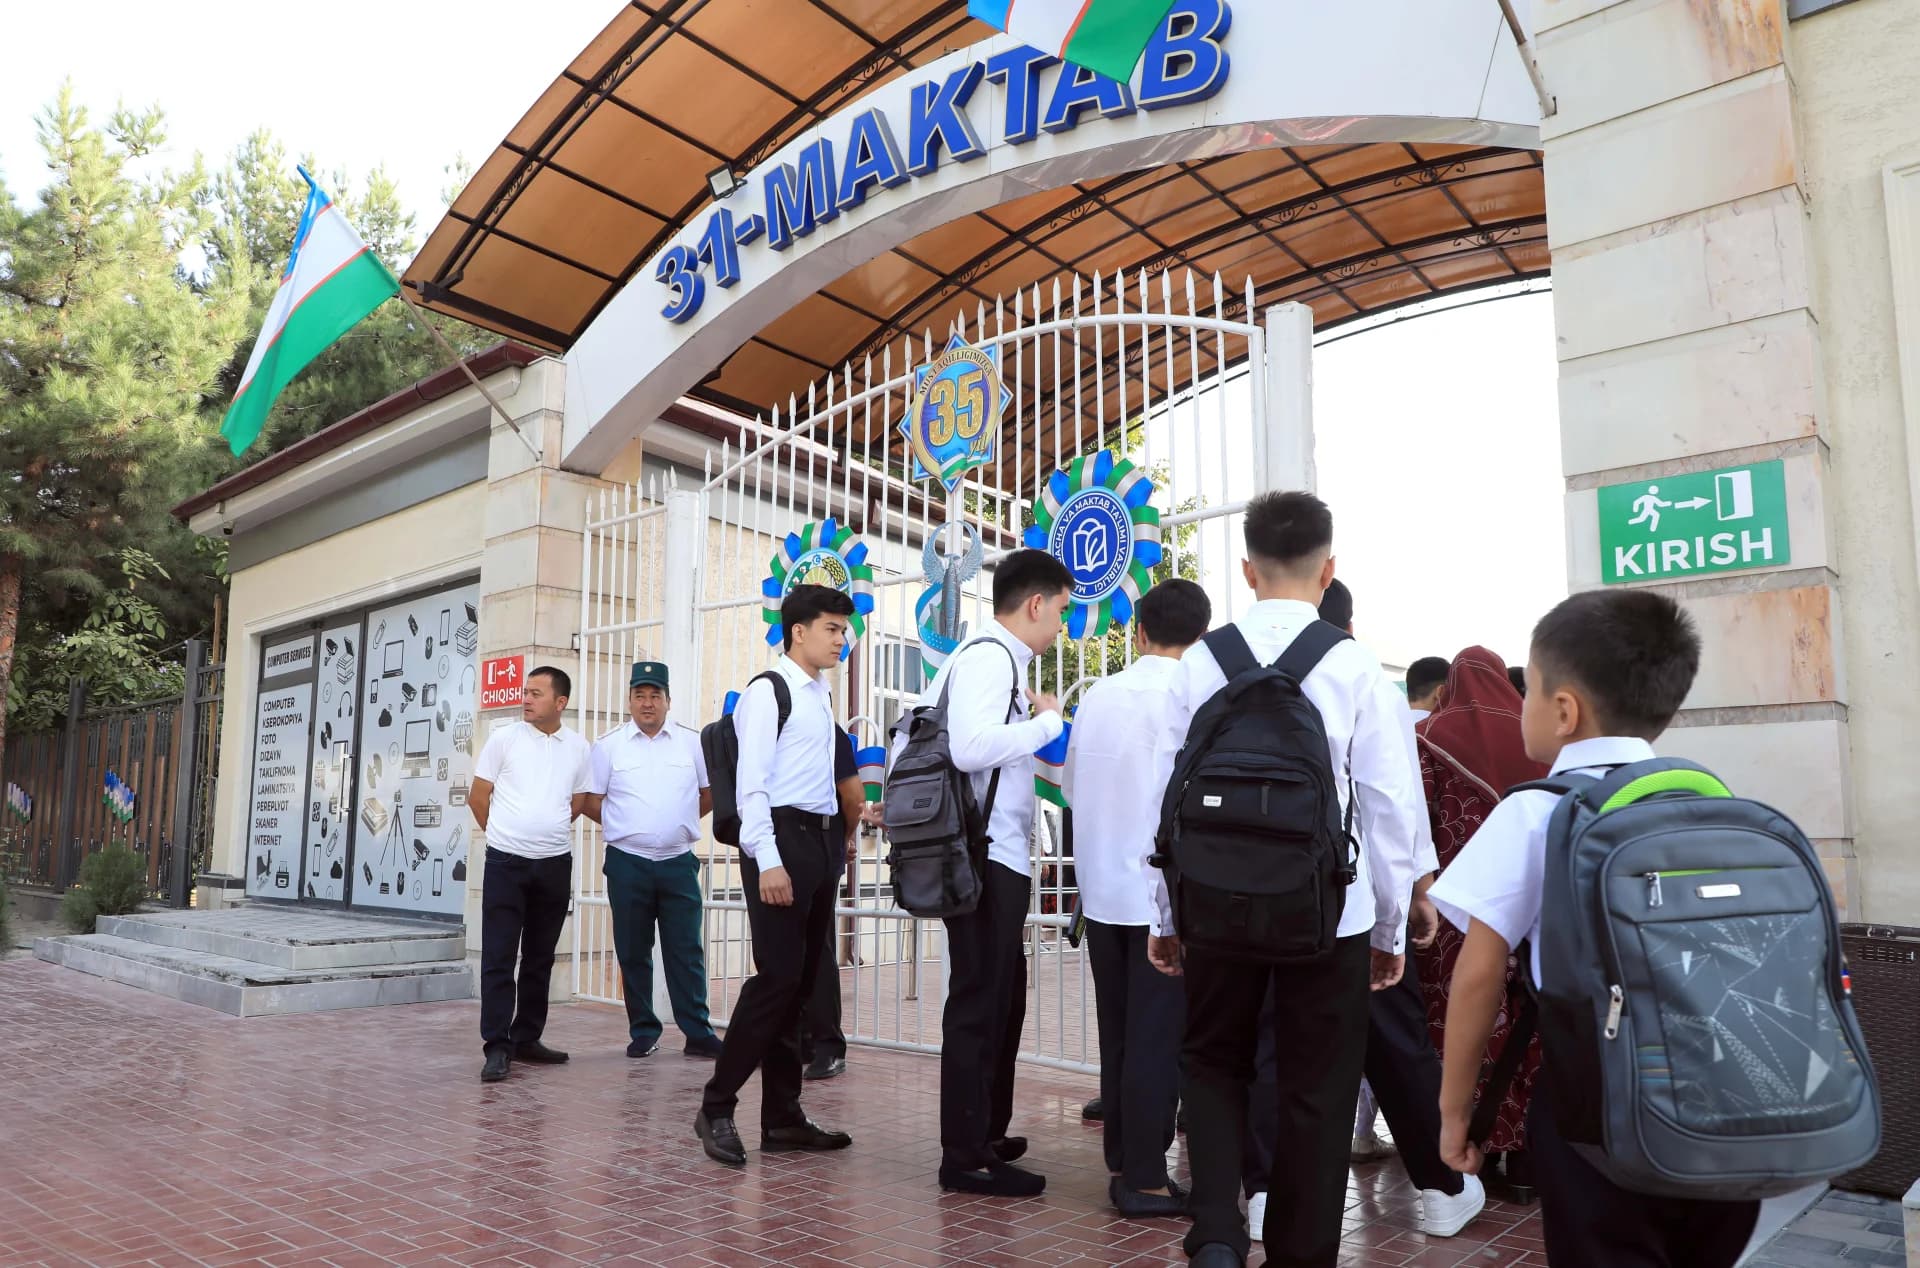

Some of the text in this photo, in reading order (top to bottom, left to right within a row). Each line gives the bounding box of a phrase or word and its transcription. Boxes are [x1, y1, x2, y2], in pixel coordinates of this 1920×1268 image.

[655, 0, 1232, 324] 31-MAKTAB
[928, 369, 984, 447] 35
[1063, 510, 1075, 523] VA
[1075, 496, 1110, 511] MAKTAB
[1094, 546, 1127, 593] VAZIRLIGI
[1614, 527, 1774, 577] KIRISH
[267, 651, 290, 669] COMPUTER
[481, 689, 522, 704] CHIQISH
[263, 697, 295, 712] COMPUTER
[262, 713, 303, 729] KSEROKOPIYA
[261, 733, 277, 745] FOTO
[260, 750, 281, 761] DIZAYN
[259, 766, 295, 778] TAKLIFNOMA
[256, 800, 289, 812] PEREPLYOT
[255, 818, 278, 829] SKANER
[254, 834, 282, 846] INTERNET
